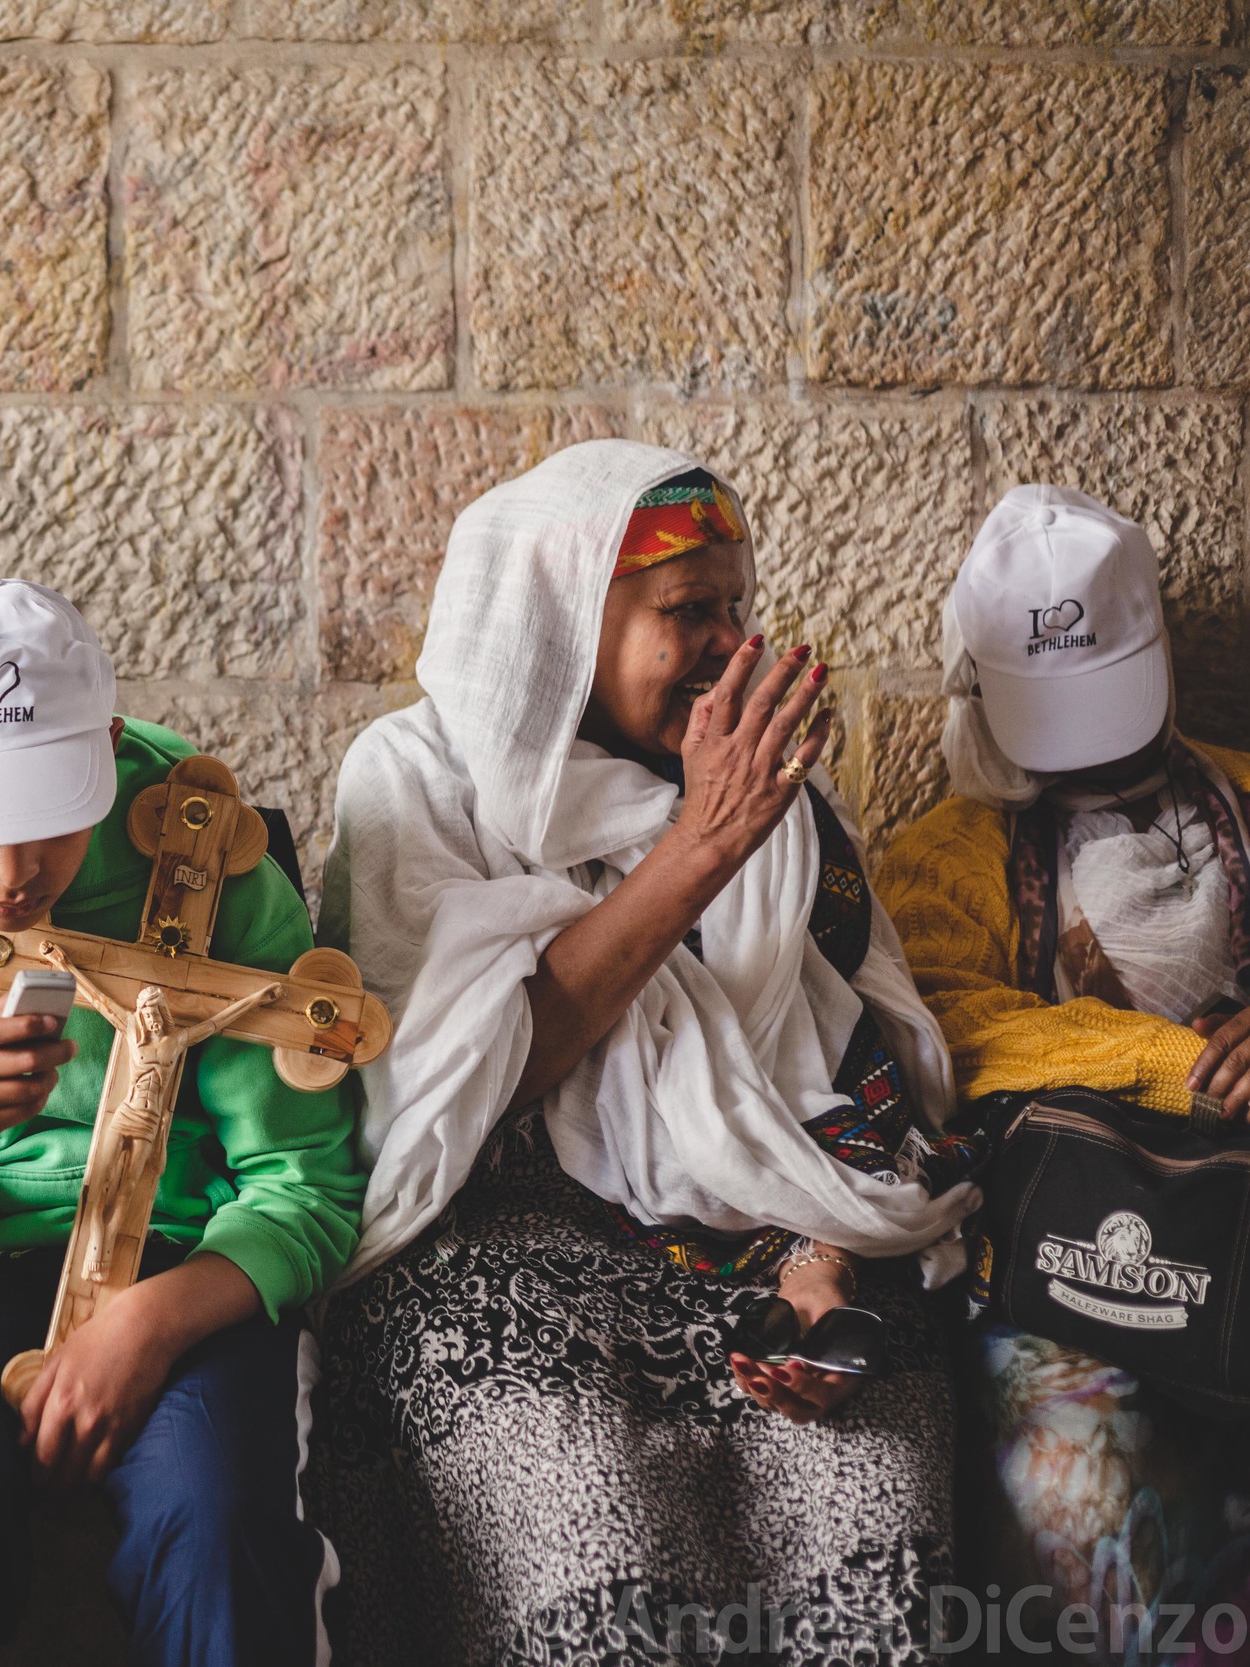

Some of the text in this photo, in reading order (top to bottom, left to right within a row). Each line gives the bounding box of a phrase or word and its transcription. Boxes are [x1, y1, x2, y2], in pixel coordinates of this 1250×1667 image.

[1028, 608, 1044, 639] I
[1027, 632, 1097, 656] BETHLEHEM
[176, 868, 205, 887] INRI
[1037, 1241, 1212, 1305] SAMSON
[1061, 1290, 1174, 1324] HALFZWARE SHAG
